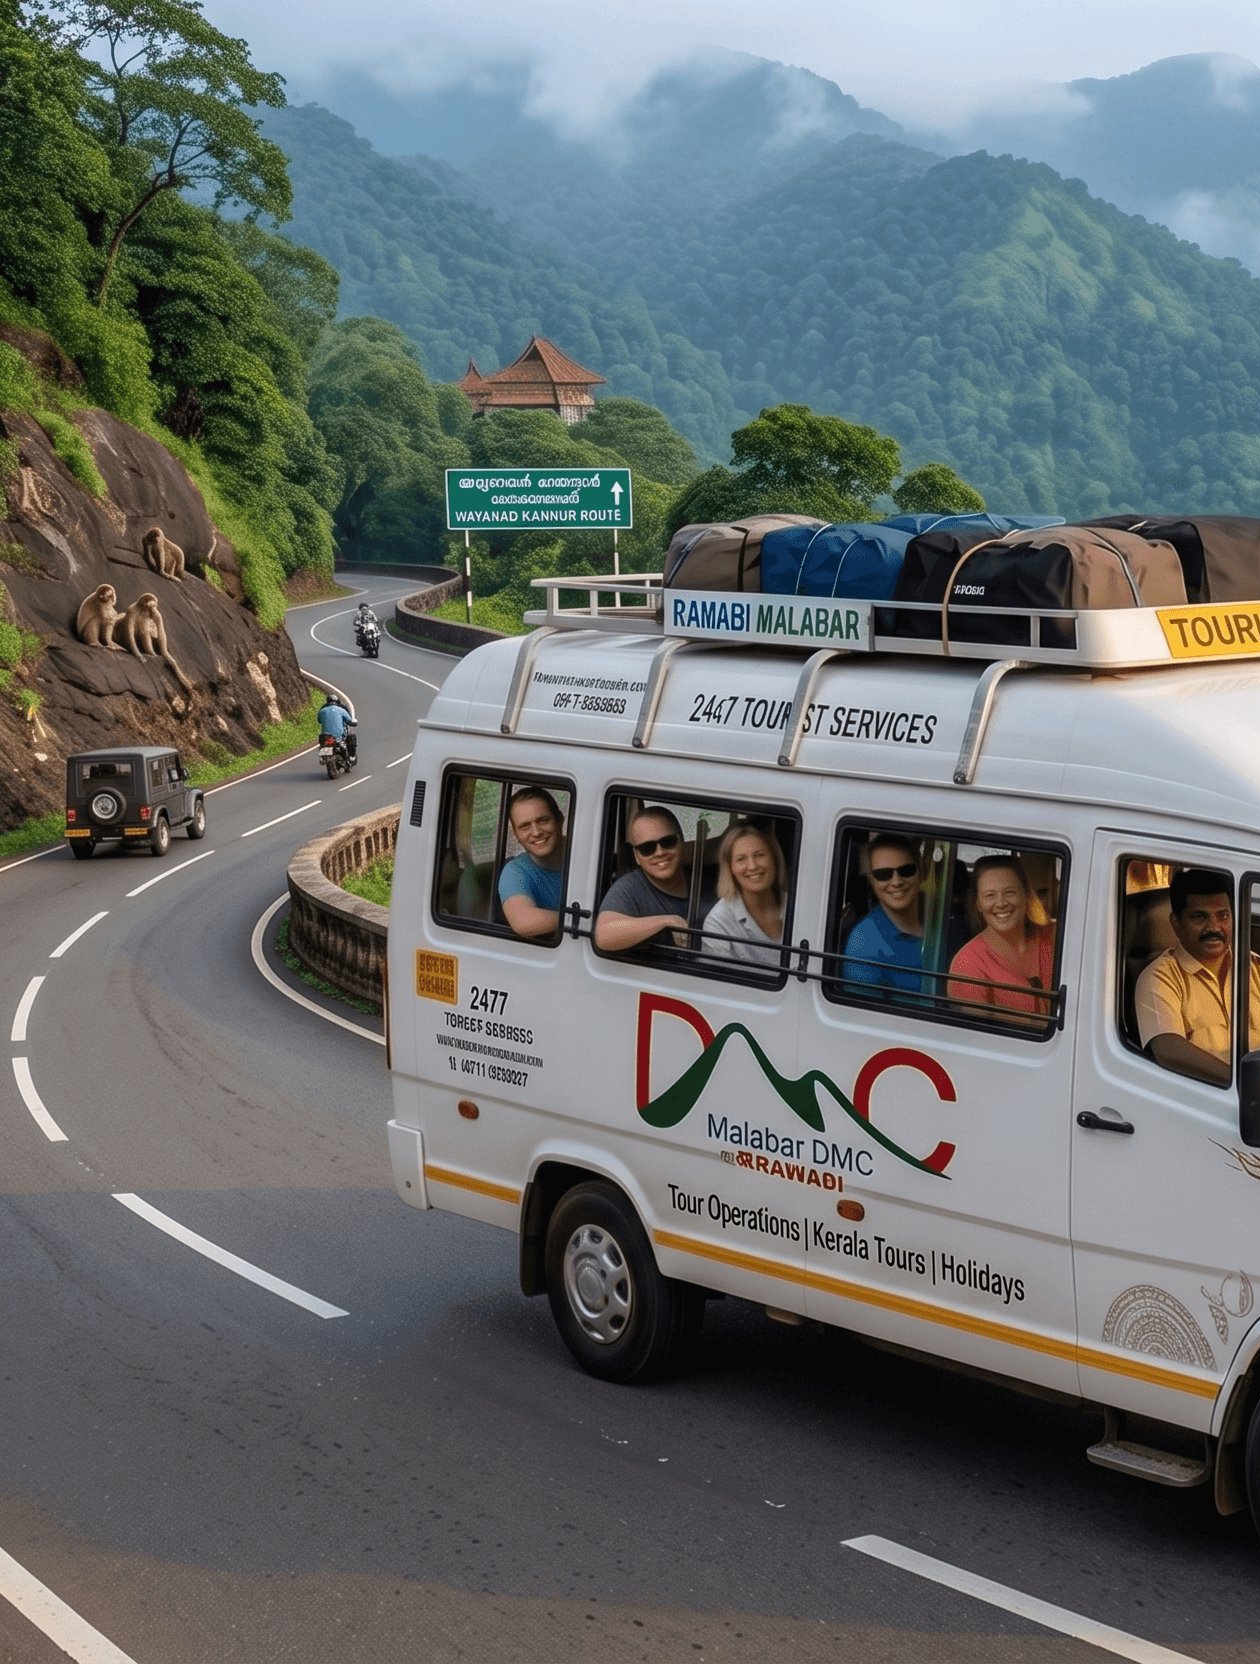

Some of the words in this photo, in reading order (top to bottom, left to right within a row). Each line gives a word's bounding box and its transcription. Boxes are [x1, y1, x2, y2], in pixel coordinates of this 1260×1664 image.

[455, 510, 519, 522] WAYANAD
[522, 509, 577, 522] KANNUR
[580, 509, 622, 521] ROUTE
[673, 598, 751, 633] RAMABI
[756, 604, 860, 641] MALABAR
[741, 697, 830, 735] TOURST
[829, 705, 938, 745] SERVICES
[470, 985, 509, 1016] 2477
[707, 1113, 805, 1160] Malabar
[812, 1138, 874, 1176] DMC
[667, 1182, 705, 1217] Tour
[707, 1193, 801, 1243] Operations
[812, 1219, 870, 1261] Kerala
[873, 1235, 927, 1275] Tours
[941, 1253, 1026, 1305] Holidays
